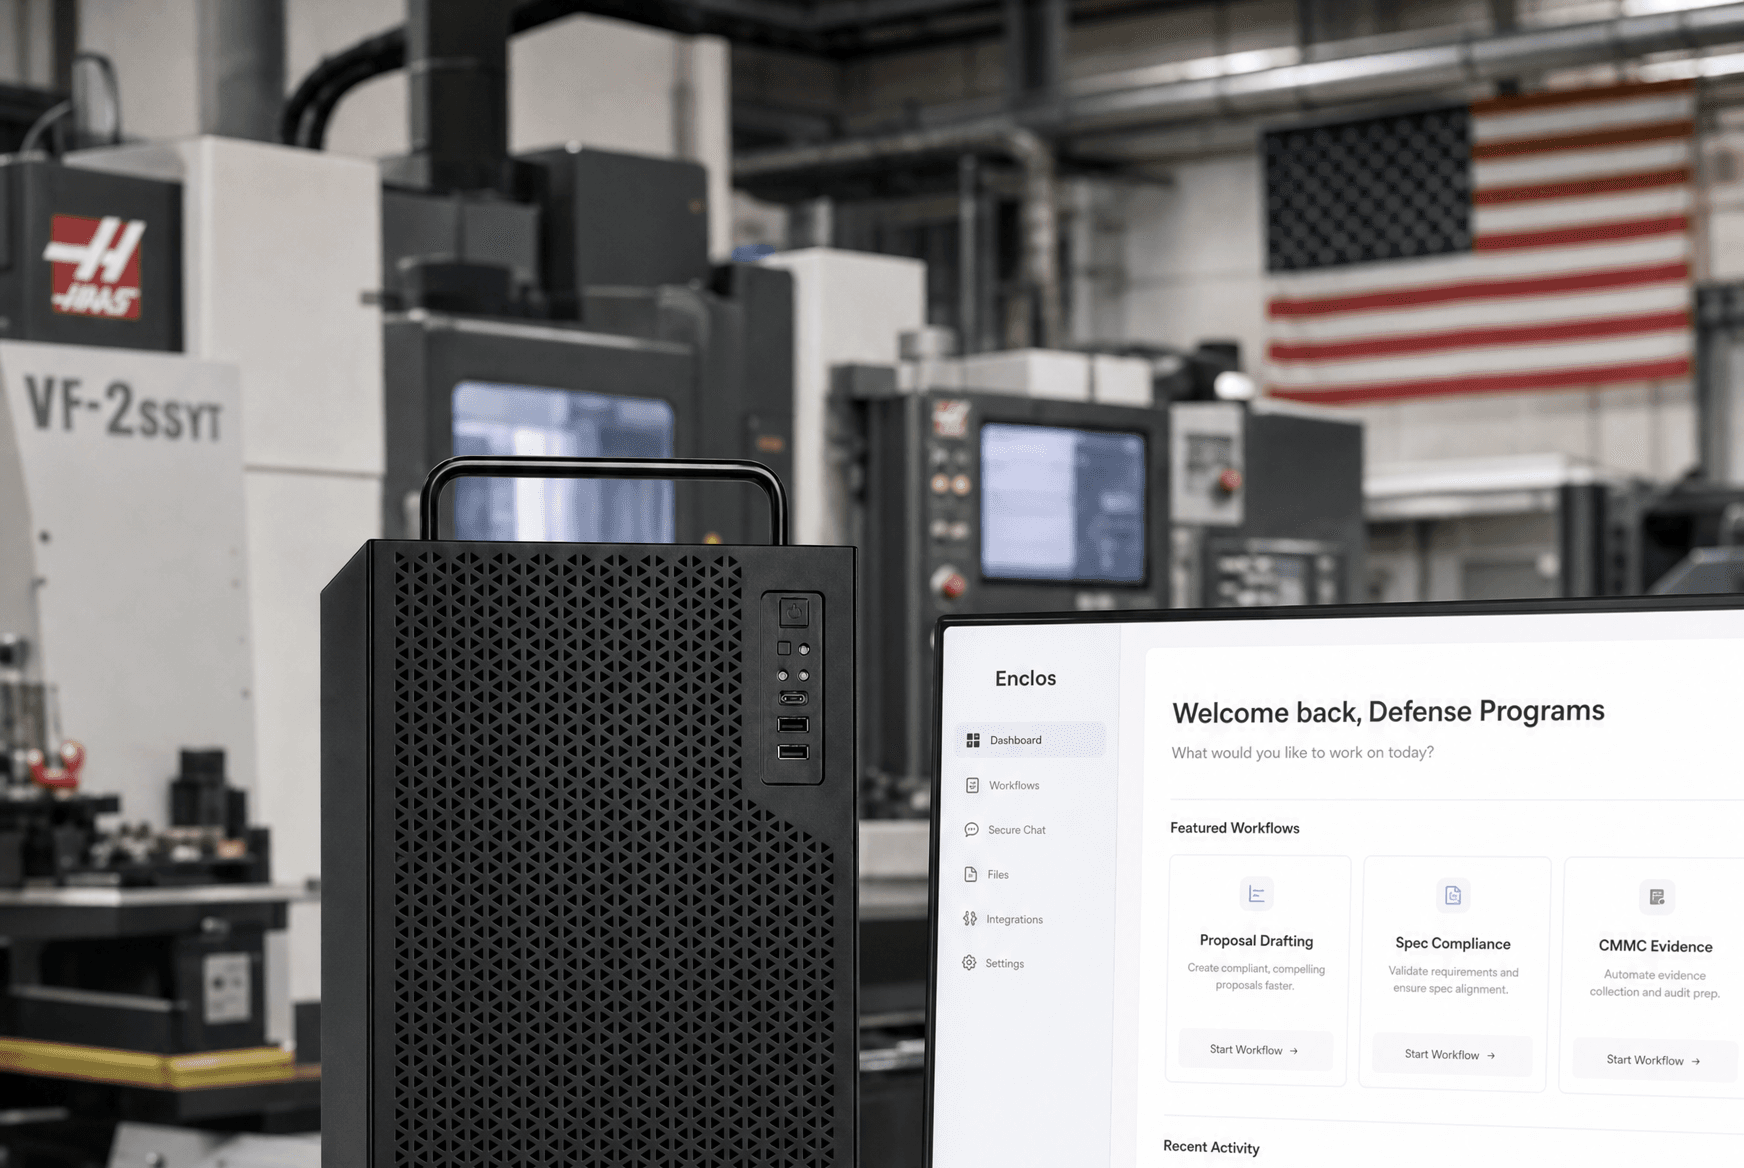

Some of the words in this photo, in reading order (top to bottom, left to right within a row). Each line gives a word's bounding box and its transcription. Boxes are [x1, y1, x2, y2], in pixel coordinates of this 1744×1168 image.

[995, 669, 1057, 687] Enclos
[1172, 701, 1290, 724] Welcome
[1297, 700, 1362, 727] back,
[1369, 699, 1472, 723] Defense
[1480, 699, 1605, 729] Programs
[990, 734, 1042, 745] Dashboard
[1171, 745, 1208, 760] What
[1210, 745, 1253, 760] would
[1255, 749, 1281, 763] you
[1284, 745, 1308, 759] like
[1310, 747, 1326, 759] to
[1329, 745, 1363, 759] work
[1366, 748, 1384, 759] on
[1387, 744, 1435, 763] today?
[988, 780, 1040, 791] Workflows
[988, 824, 1022, 835] Secure
[1023, 824, 1047, 835] Chat
[1170, 821, 1228, 834] Featured
[1230, 821, 1300, 835] Workflows
[987, 869, 1010, 880] Files
[986, 914, 1044, 927] Integrations
[1200, 933, 1257, 950] Proposal
[1260, 934, 1314, 951] Drafting
[1395, 935, 1429, 952] Spec
[1431, 936, 1512, 953] Compliance
[1598, 938, 1647, 952] CMMC
[1650, 939, 1714, 954] Evidence
[985, 957, 1025, 971] Settings
[1187, 962, 1220, 973] Create
[1220, 962, 1271, 975] compliant,
[1272, 963, 1326, 977] compelling
[1388, 965, 1429, 977] Validate
[1430, 966, 1498, 979] requirements
[1499, 967, 1520, 978] and
[1603, 968, 1656, 980] Automate
[1657, 969, 1707, 981] evidence
[1215, 979, 1264, 992] proposals
[1264, 979, 1295, 991] faster.
[1392, 984, 1428, 994] ensure
[1428, 985, 1453, 996] spec
[1454, 983, 1509, 997] alignment.
[1589, 985, 1640, 998] collection
[1641, 986, 1662, 998] and
[1663, 986, 1691, 998] audit
[1692, 990, 1721, 1001] prep.
[1210, 1043, 1234, 1055] Start
[1235, 1044, 1284, 1056] Workflow
[1405, 1048, 1429, 1060] Start
[1430, 1049, 1480, 1061] Workflow
[1606, 1053, 1632, 1065] Start
[1633, 1055, 1685, 1066] Workflow
[1163, 1139, 1208, 1153] Recent
[1210, 1140, 1261, 1158] Activity
